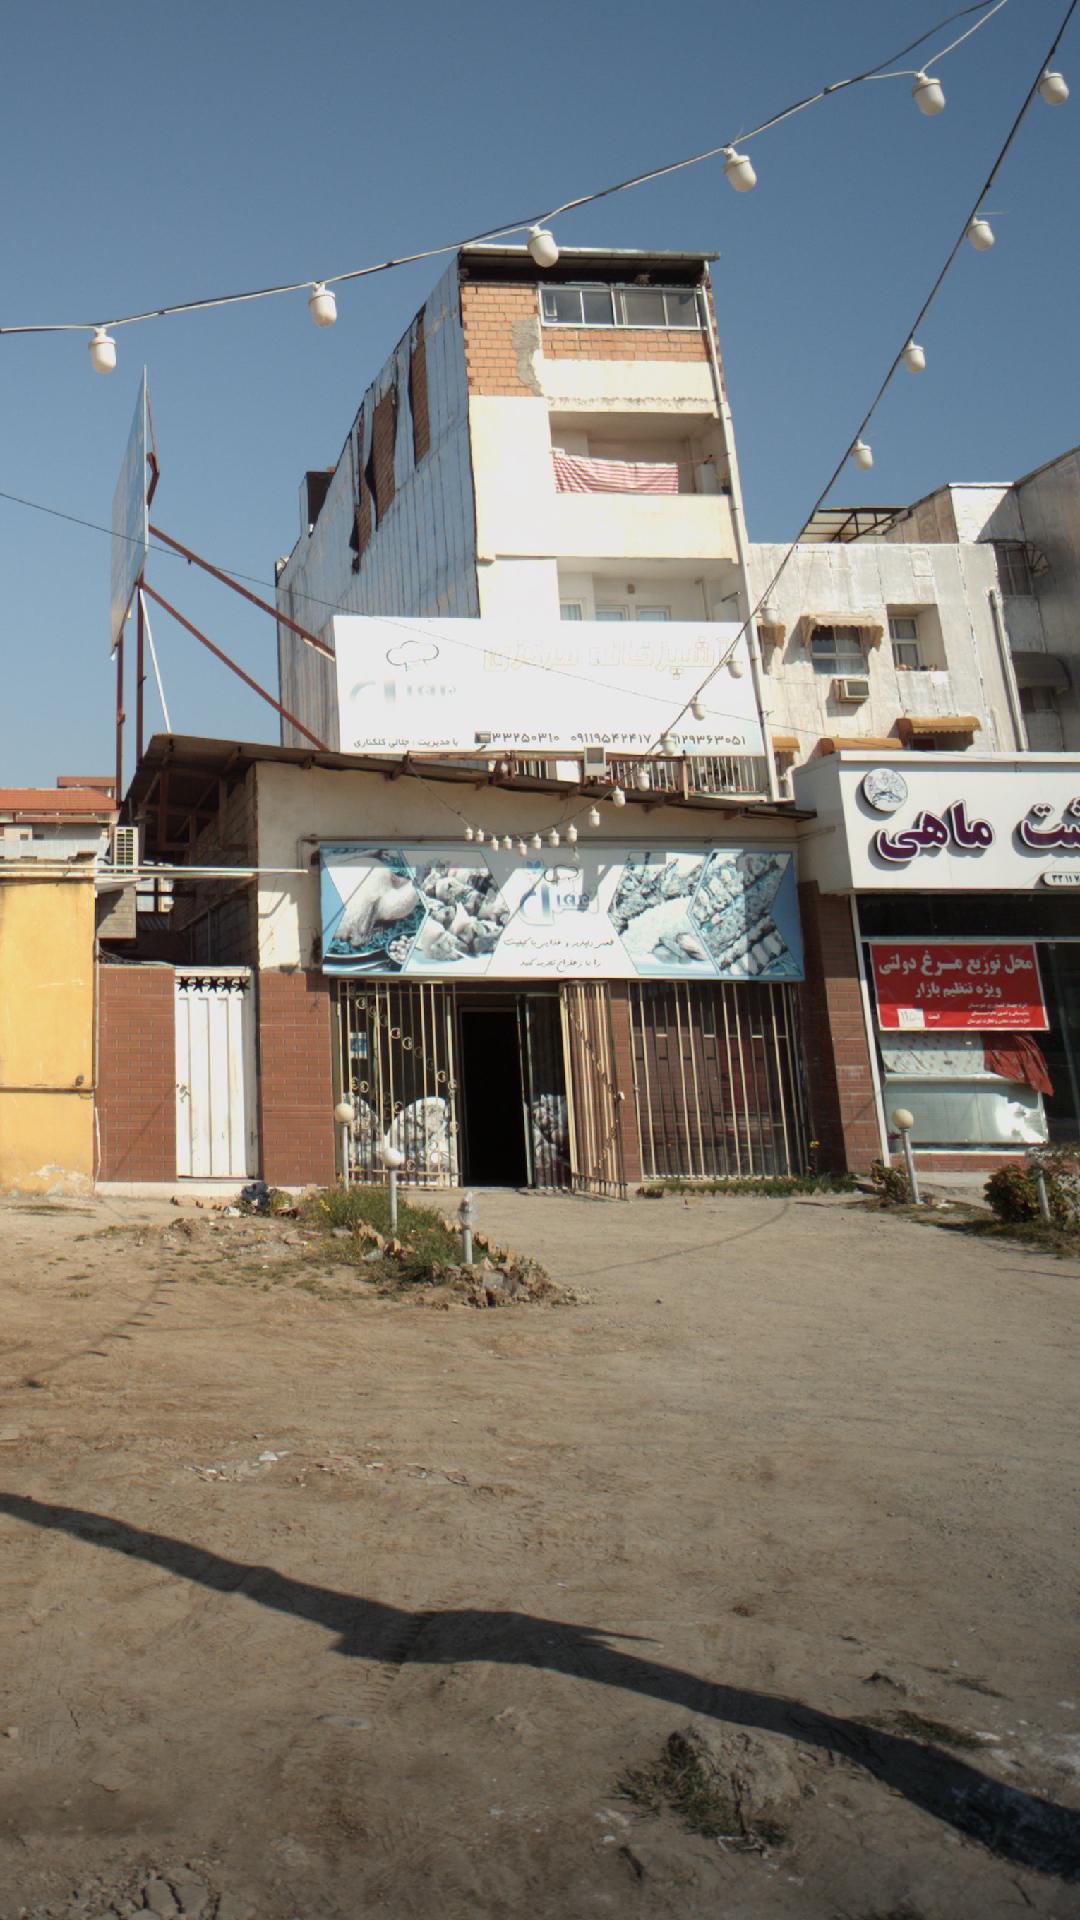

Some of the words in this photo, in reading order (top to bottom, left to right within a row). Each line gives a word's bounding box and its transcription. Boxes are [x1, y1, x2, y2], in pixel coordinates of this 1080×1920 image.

[664, 735, 747, 745] ۹۱۲۹۳۶۳۰۵۱
[877, 799, 995, 862] ماهی
[879, 953, 917, 975] دولتی
[920, 950, 962, 976] مرغ
[966, 954, 1001, 975] توزیع
[1005, 954, 1033, 974] محل
[915, 982, 941, 998] بازار
[943, 982, 973, 998] تنظیم
[976, 983, 1002, 998] ویژه
